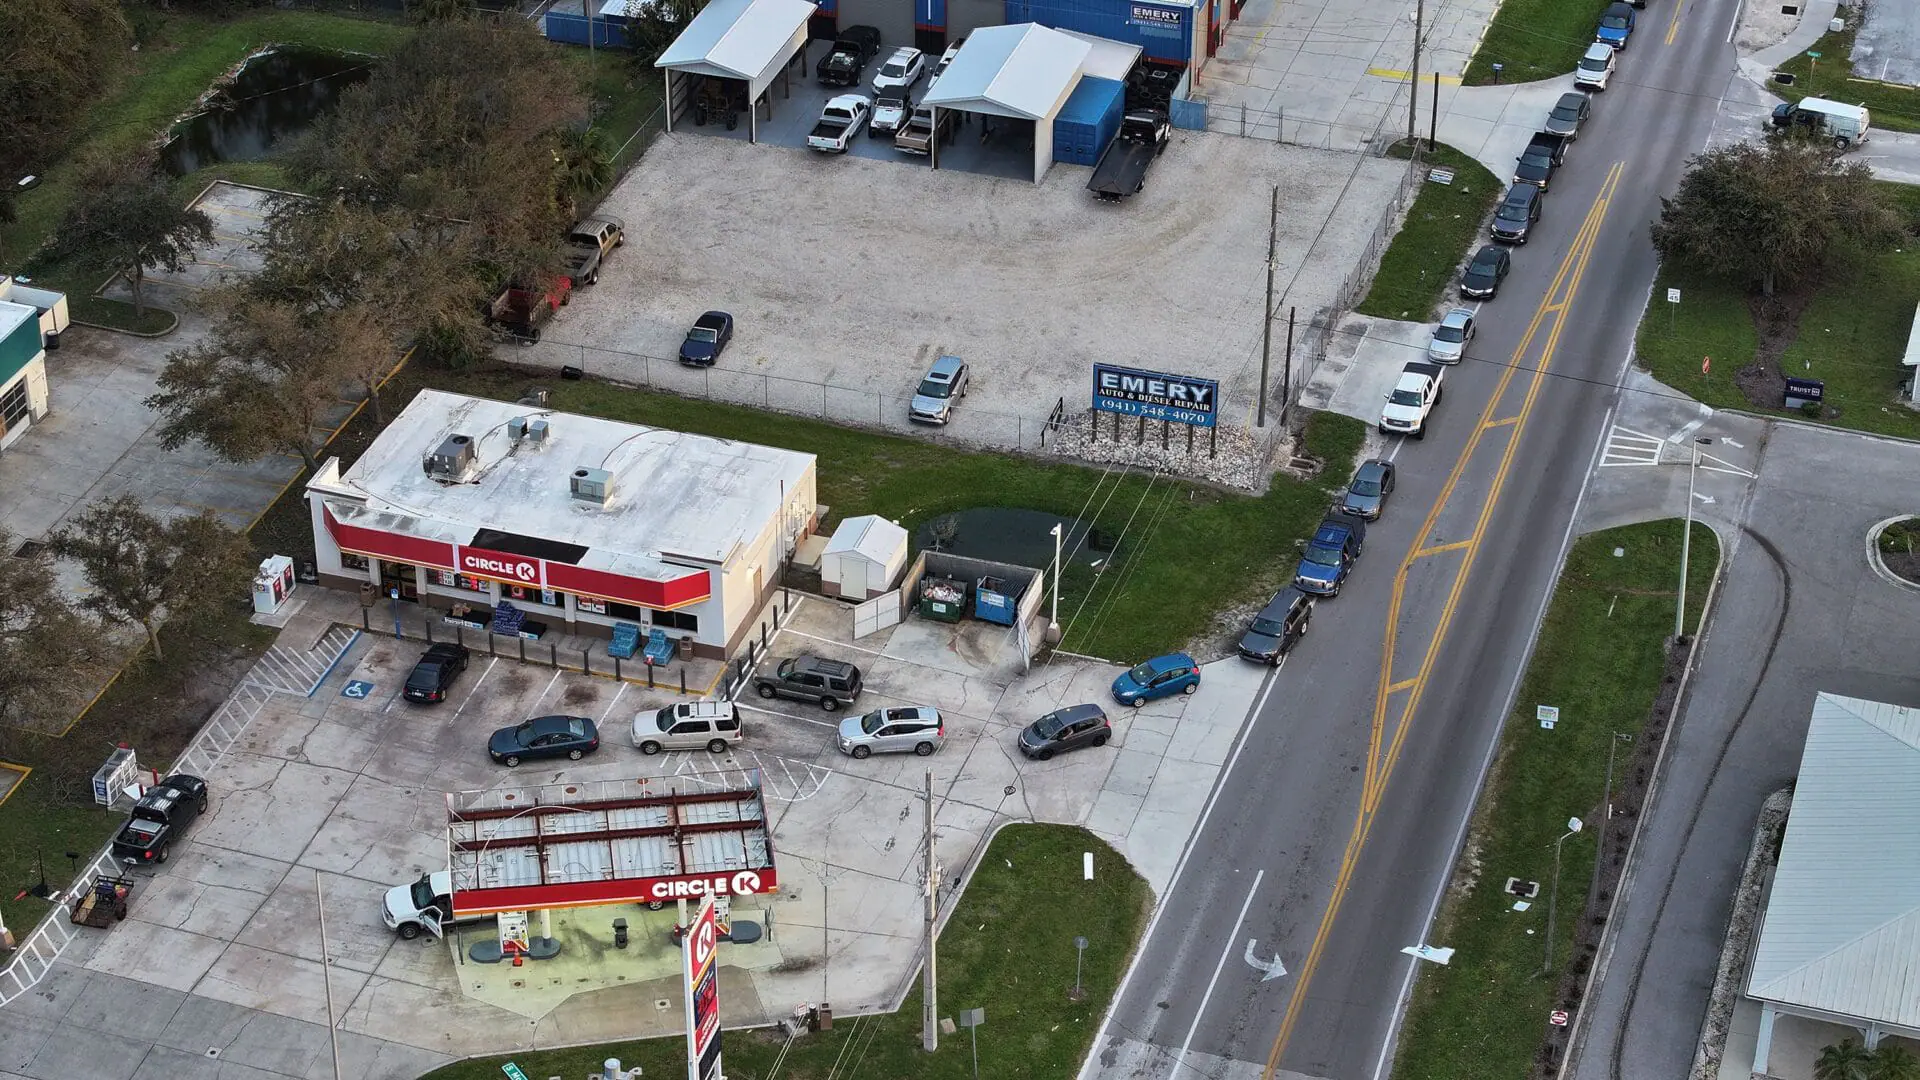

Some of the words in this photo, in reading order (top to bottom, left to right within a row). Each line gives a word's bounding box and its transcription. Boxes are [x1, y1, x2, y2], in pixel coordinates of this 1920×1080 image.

[1133, 7, 1179, 20] EMERY
[1099, 388, 1124, 398] AUTO
[1138, 394, 1172, 405] DIESEL
[1174, 400, 1210, 412] REPAIR
[1101, 373, 1209, 403] EMERY
[1790, 385, 1811, 394] TRUIST
[1101, 399, 1136, 412] (941)
[1141, 405, 1205, 423] 548-4070
[465, 555, 514, 575] CIRCLE
[519, 564, 534, 580] K
[652, 877, 727, 898] CIRCLE
[735, 873, 760, 895] K
